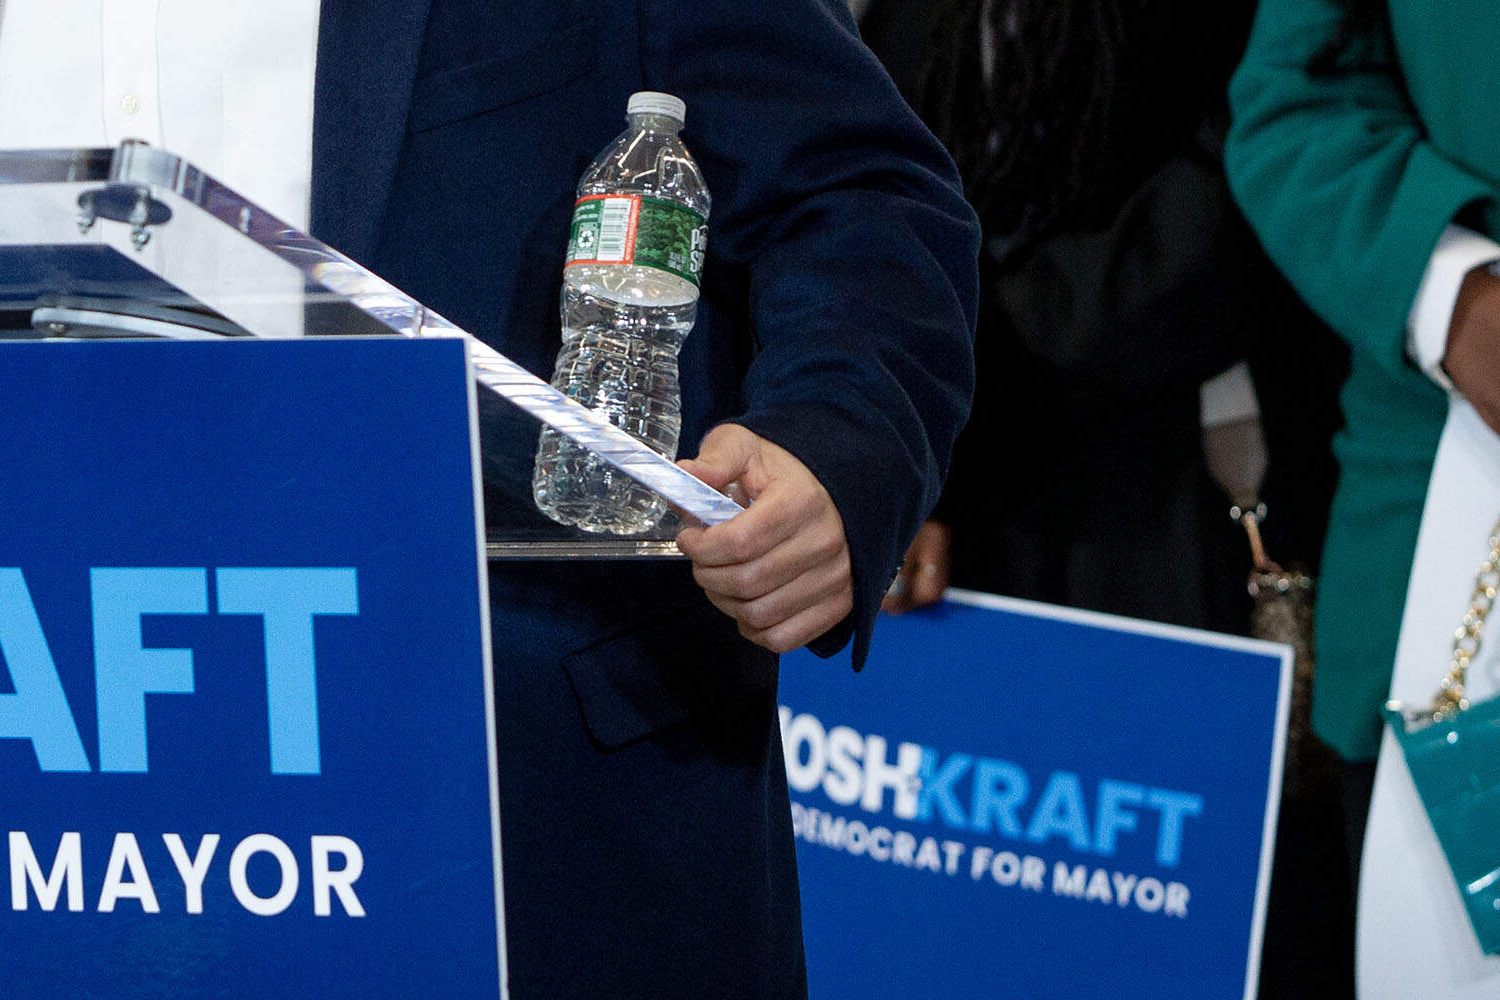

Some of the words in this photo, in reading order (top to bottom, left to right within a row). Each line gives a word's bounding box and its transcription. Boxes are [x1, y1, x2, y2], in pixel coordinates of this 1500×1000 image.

[777, 705, 1202, 869] OSHKRAFT
[9, 831, 366, 918] MAYOR
[970, 846, 1048, 893] FOR
[1052, 860, 1192, 919] MAYOR
